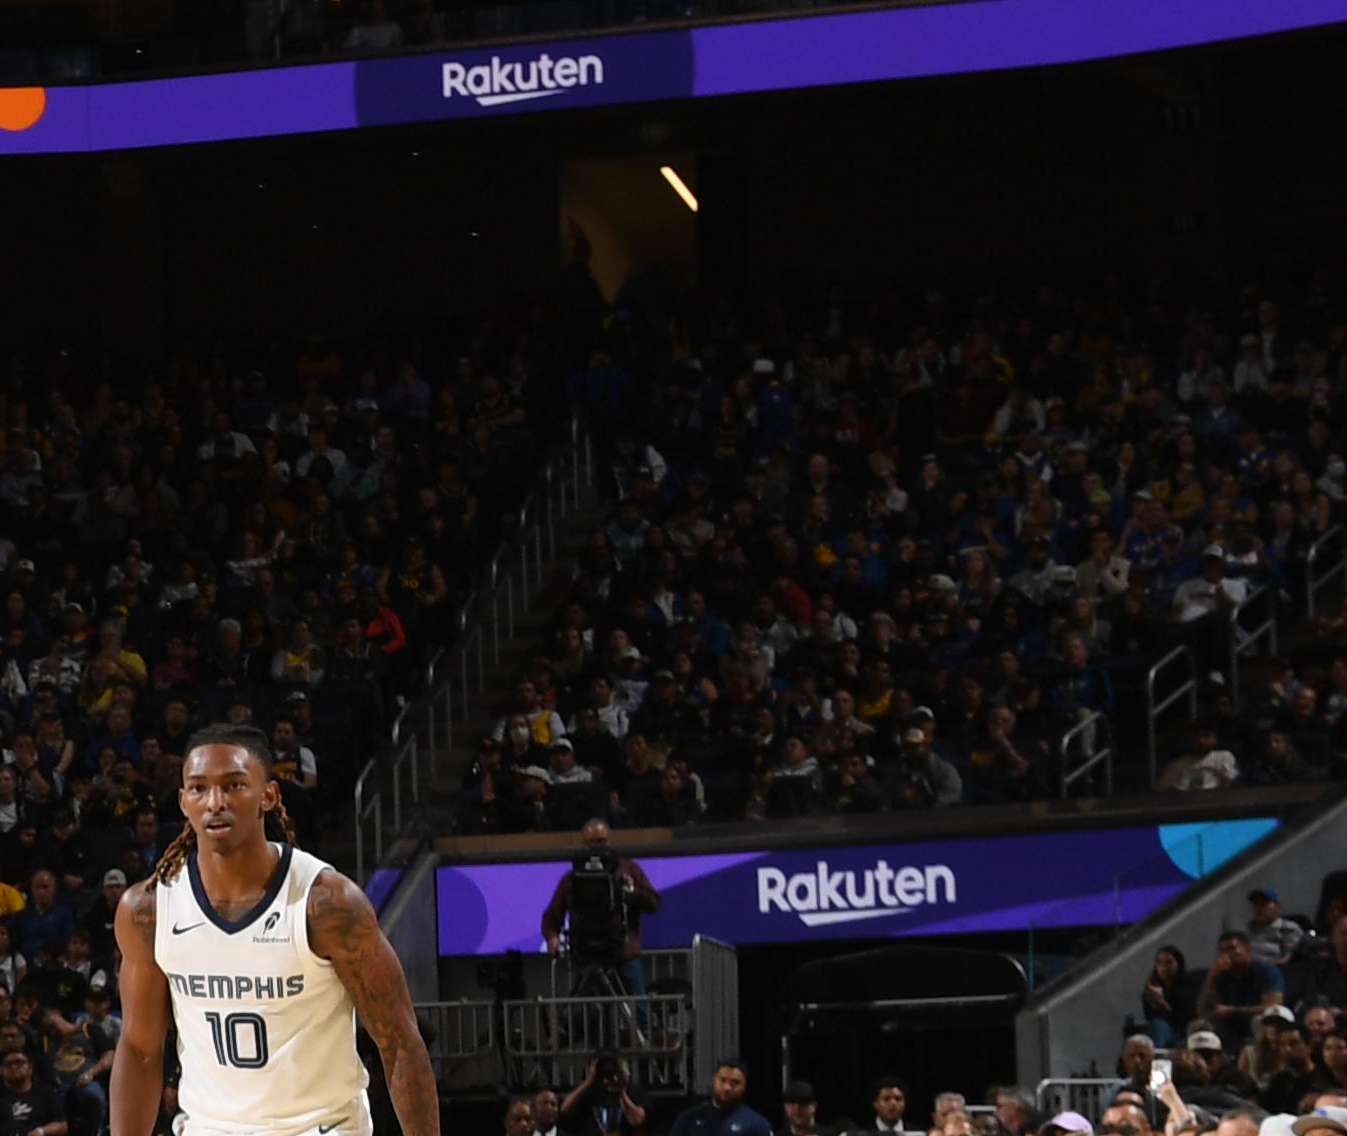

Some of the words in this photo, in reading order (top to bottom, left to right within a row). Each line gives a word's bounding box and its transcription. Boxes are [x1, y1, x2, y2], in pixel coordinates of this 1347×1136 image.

[441, 53, 604, 98] Rakuten
[757, 859, 956, 914] Rakuten
[168, 972, 305, 1000] MEMPHIS
[204, 1011, 269, 1070] 10
